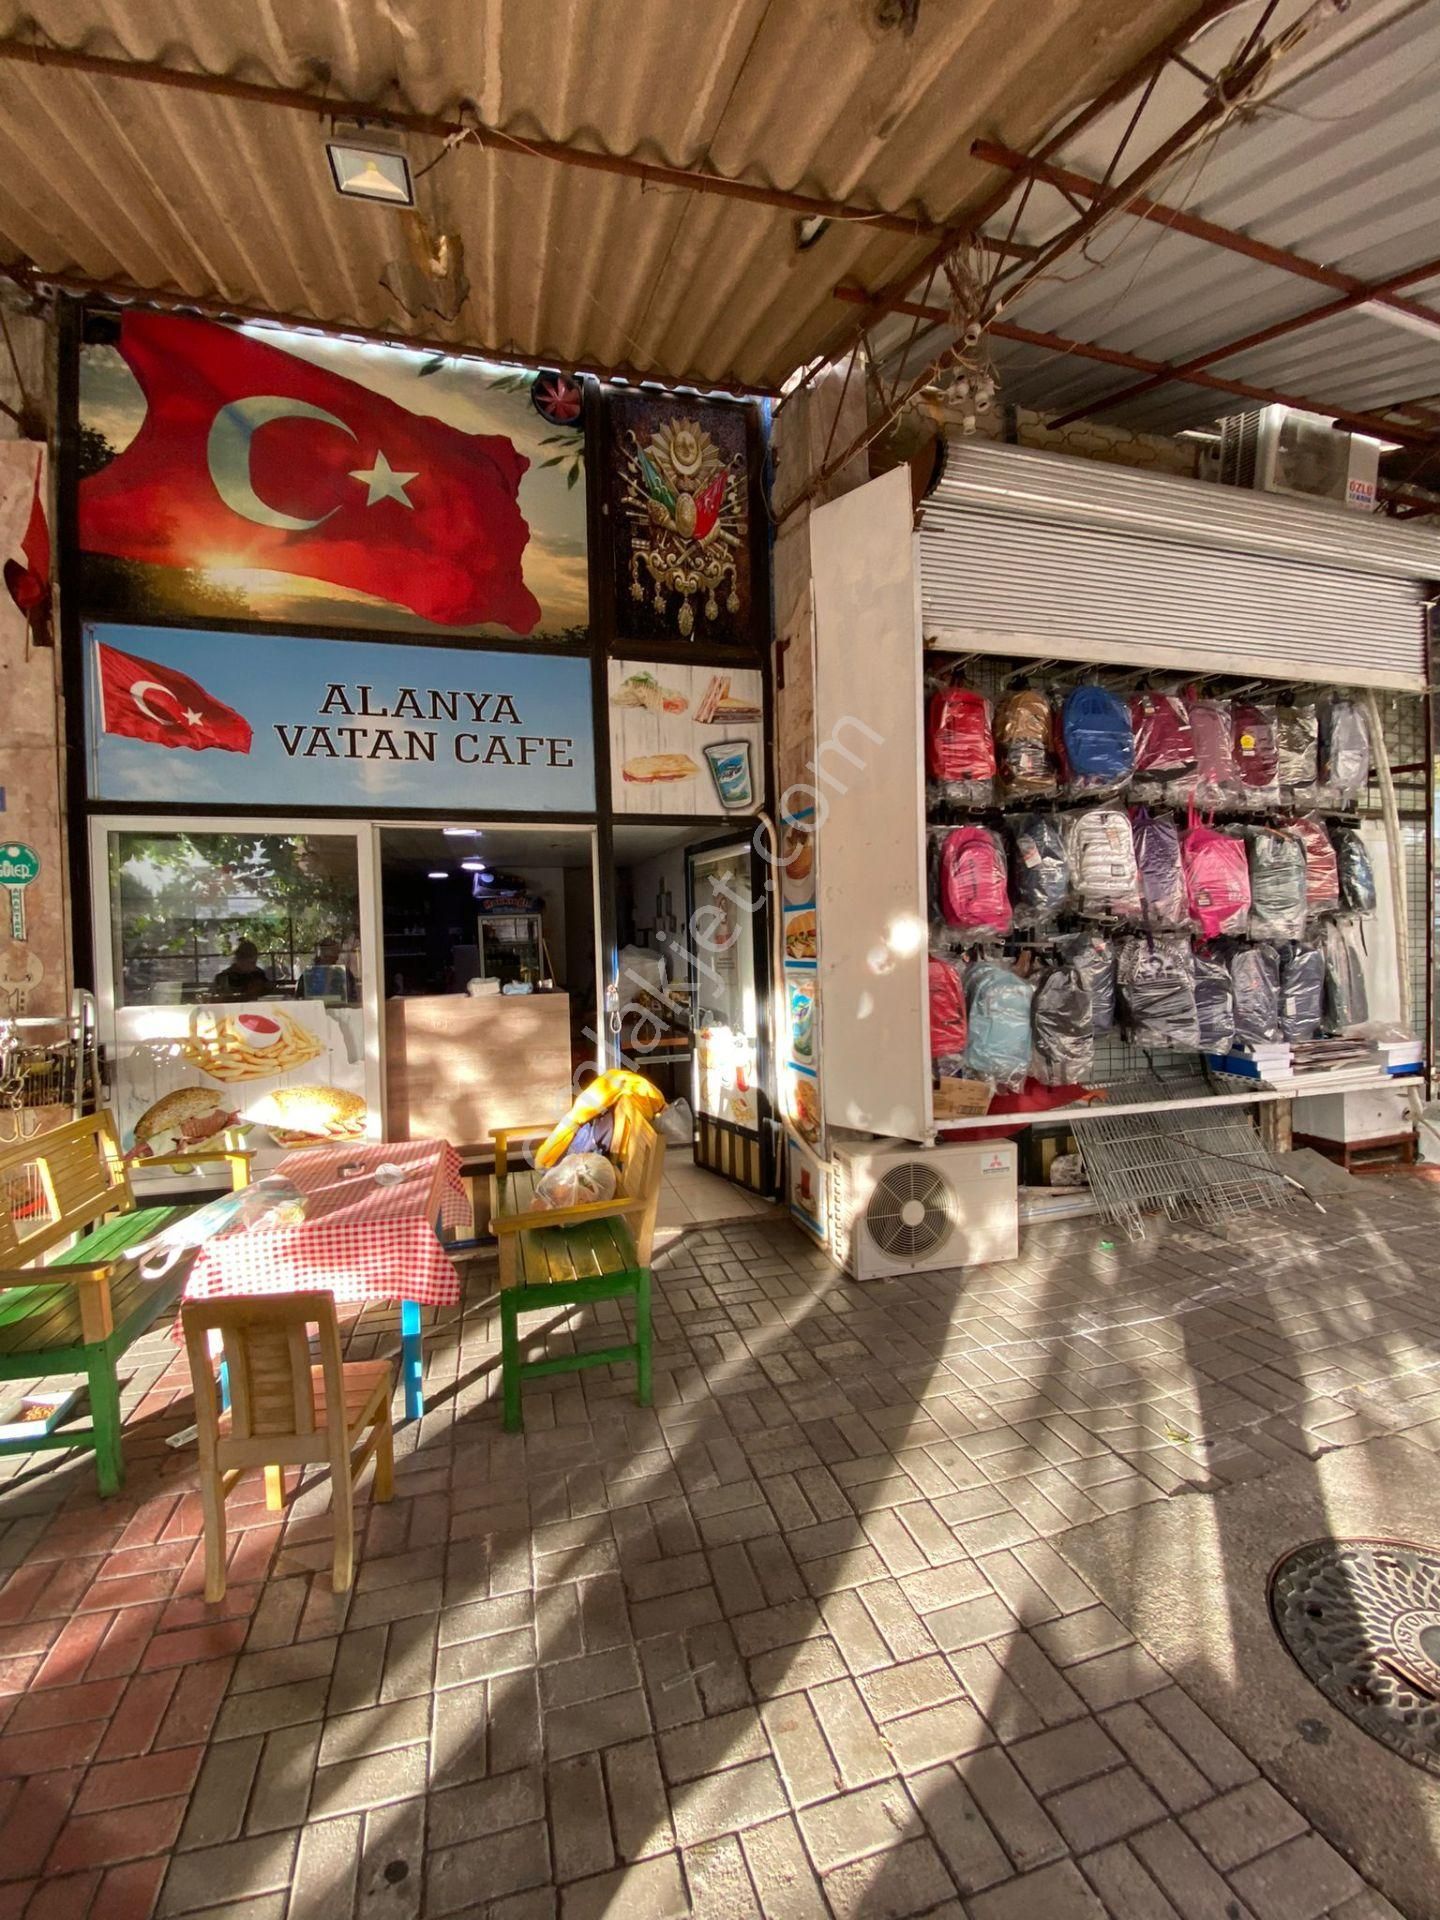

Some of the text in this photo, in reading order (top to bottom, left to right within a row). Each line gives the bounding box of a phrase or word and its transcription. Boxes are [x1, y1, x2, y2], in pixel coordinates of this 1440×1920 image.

[318, 683, 523, 725] ALANYA
[272, 724, 575, 768] VATAN CAFE
